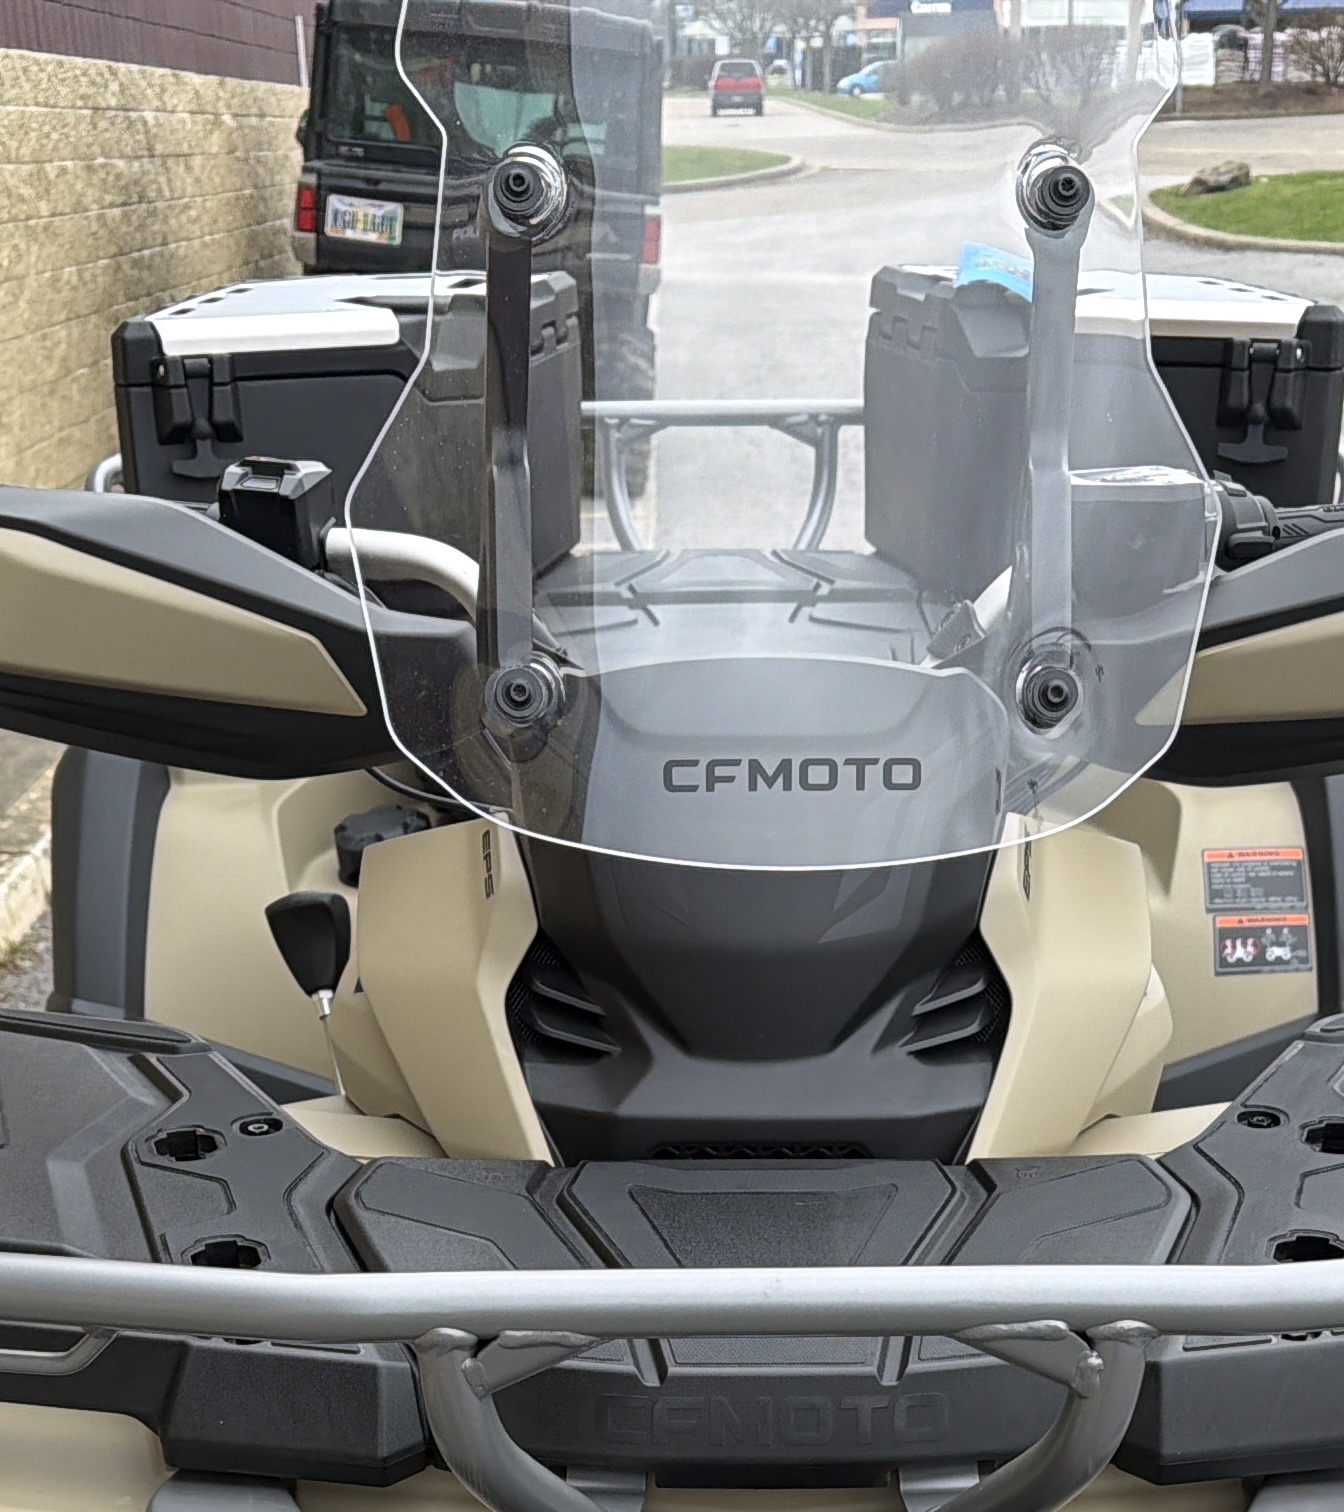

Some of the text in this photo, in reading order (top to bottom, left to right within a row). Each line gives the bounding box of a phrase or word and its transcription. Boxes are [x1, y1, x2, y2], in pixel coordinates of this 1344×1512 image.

[663, 757, 922, 793] CFMOTO
[482, 828, 494, 899] EPS
[594, 1392, 950, 1447] CFMOTO
